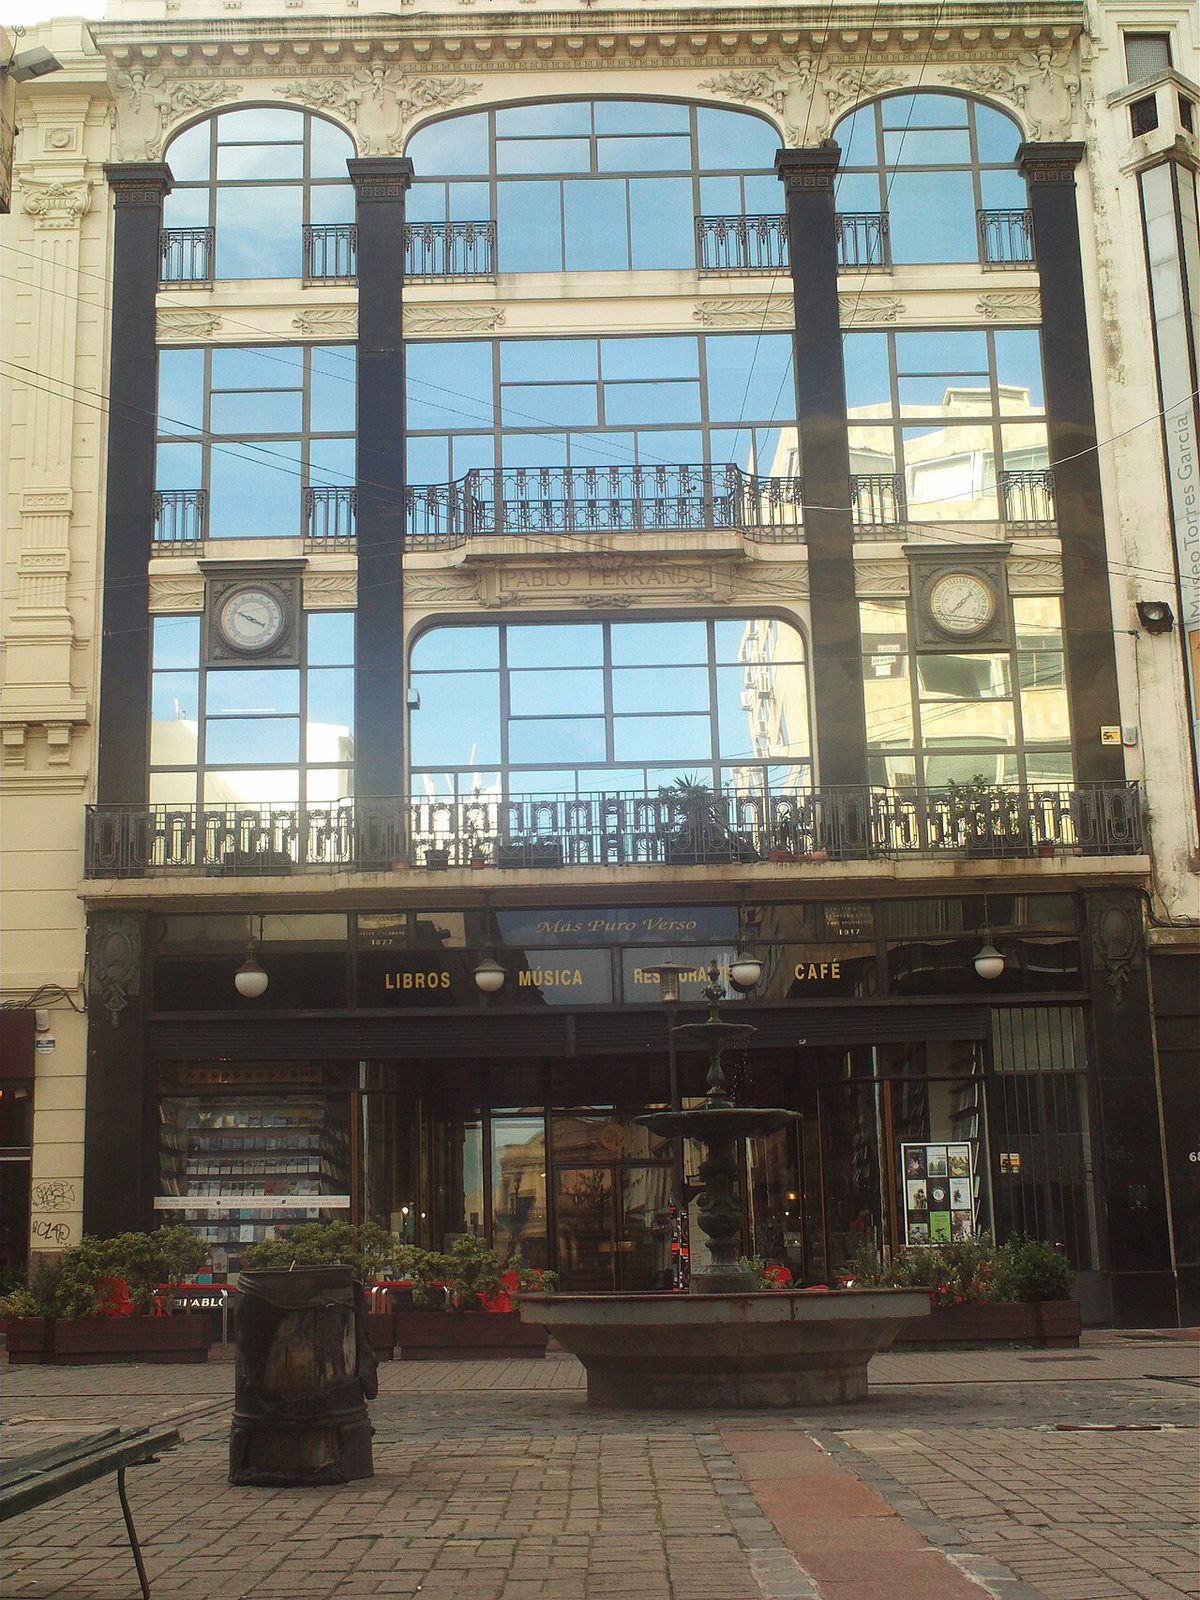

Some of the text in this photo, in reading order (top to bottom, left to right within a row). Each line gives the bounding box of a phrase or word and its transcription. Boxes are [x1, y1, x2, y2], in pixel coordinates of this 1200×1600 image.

[1173, 415, 1193, 480] García
[1183, 484, 1200, 551] Torres
[505, 566, 705, 587] PABLO FERRANDO
[536, 916, 698, 934] Más Puro Verso
[518, 965, 583, 987] MÚSICA
[794, 957, 841, 980] CAFÉ
[385, 971, 451, 990] LIBROS
